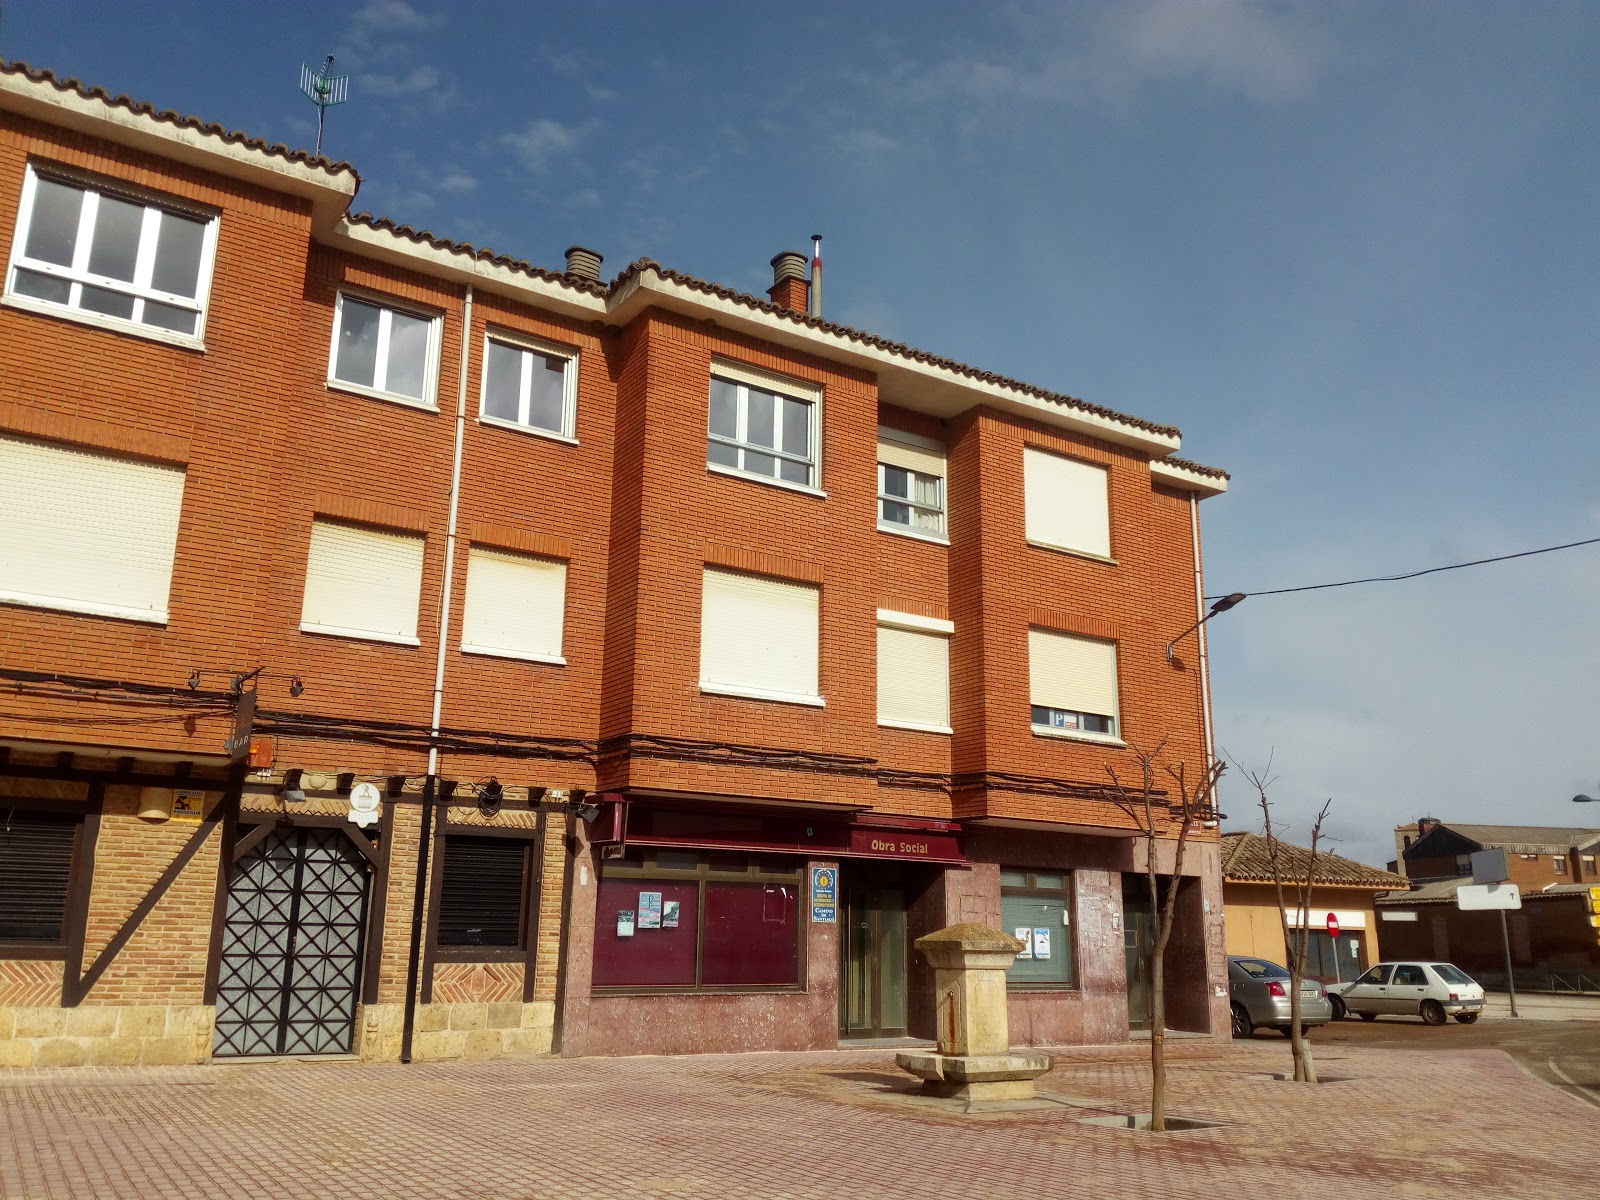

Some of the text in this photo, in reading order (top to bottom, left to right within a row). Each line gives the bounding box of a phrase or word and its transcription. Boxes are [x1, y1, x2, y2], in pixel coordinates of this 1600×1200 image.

[233, 735, 249, 749] BAR
[871, 839, 928, 854] Obra Social
